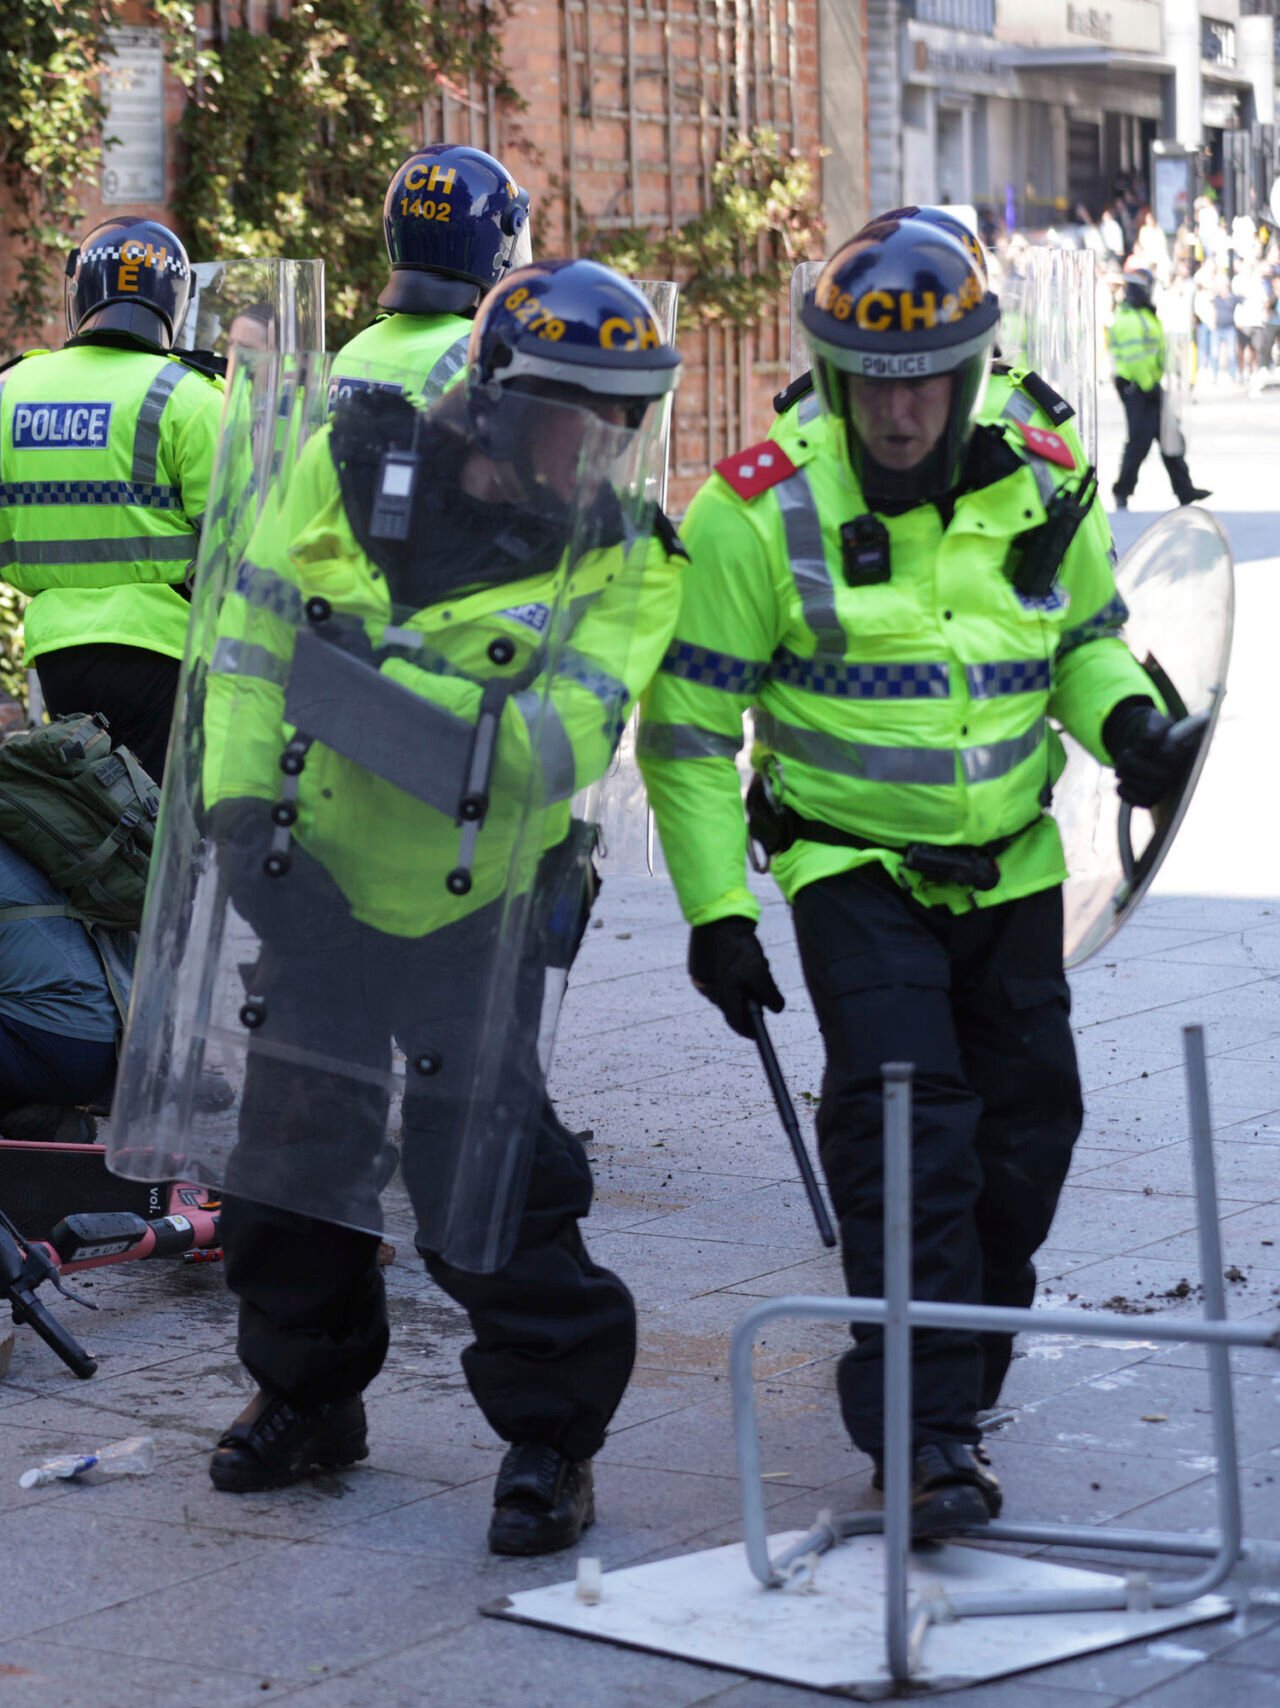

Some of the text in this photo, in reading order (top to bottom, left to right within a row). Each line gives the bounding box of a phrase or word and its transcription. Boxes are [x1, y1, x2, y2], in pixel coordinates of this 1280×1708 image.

[404, 164, 457, 195] CH
[400, 196, 452, 222] 1402
[120, 239, 168, 272] CH
[117, 264, 140, 292] E
[504, 287, 567, 342] 8279
[855, 290, 937, 332] CH
[598, 316, 661, 351] CH
[861, 357, 927, 374] POLICE
[14, 408, 106, 442] POLICE
[149, 1187, 161, 1214] voi.
